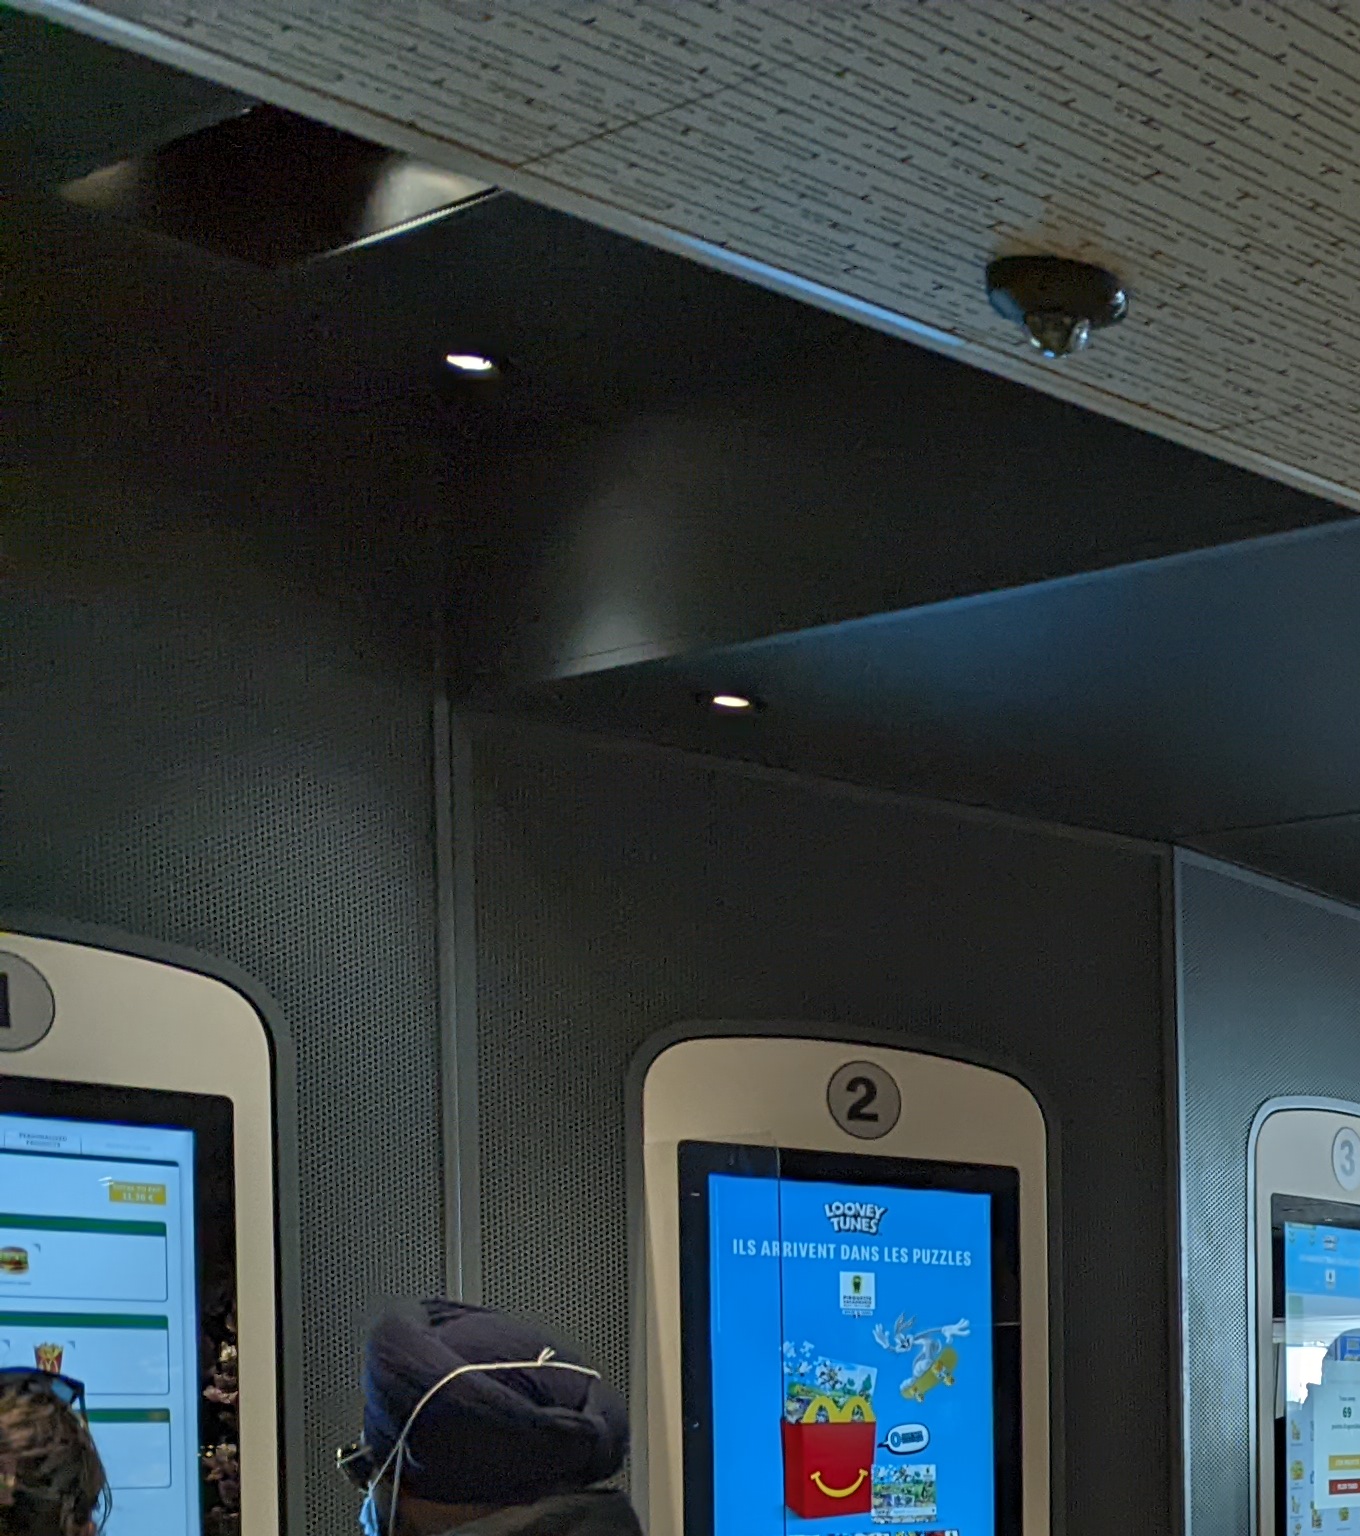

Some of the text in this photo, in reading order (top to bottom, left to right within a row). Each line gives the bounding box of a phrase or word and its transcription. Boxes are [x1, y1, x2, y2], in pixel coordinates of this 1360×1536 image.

[846, 1076, 879, 1122] 2
[1340, 1140, 1356, 1176] 3
[824, 1202, 886, 1220] LOONEY
[830, 1217, 878, 1234] TUNES
[733, 1238, 972, 1266] ILS ARRIVENT DANS LES PUZZLES
[1342, 1406, 1352, 1418] 69
